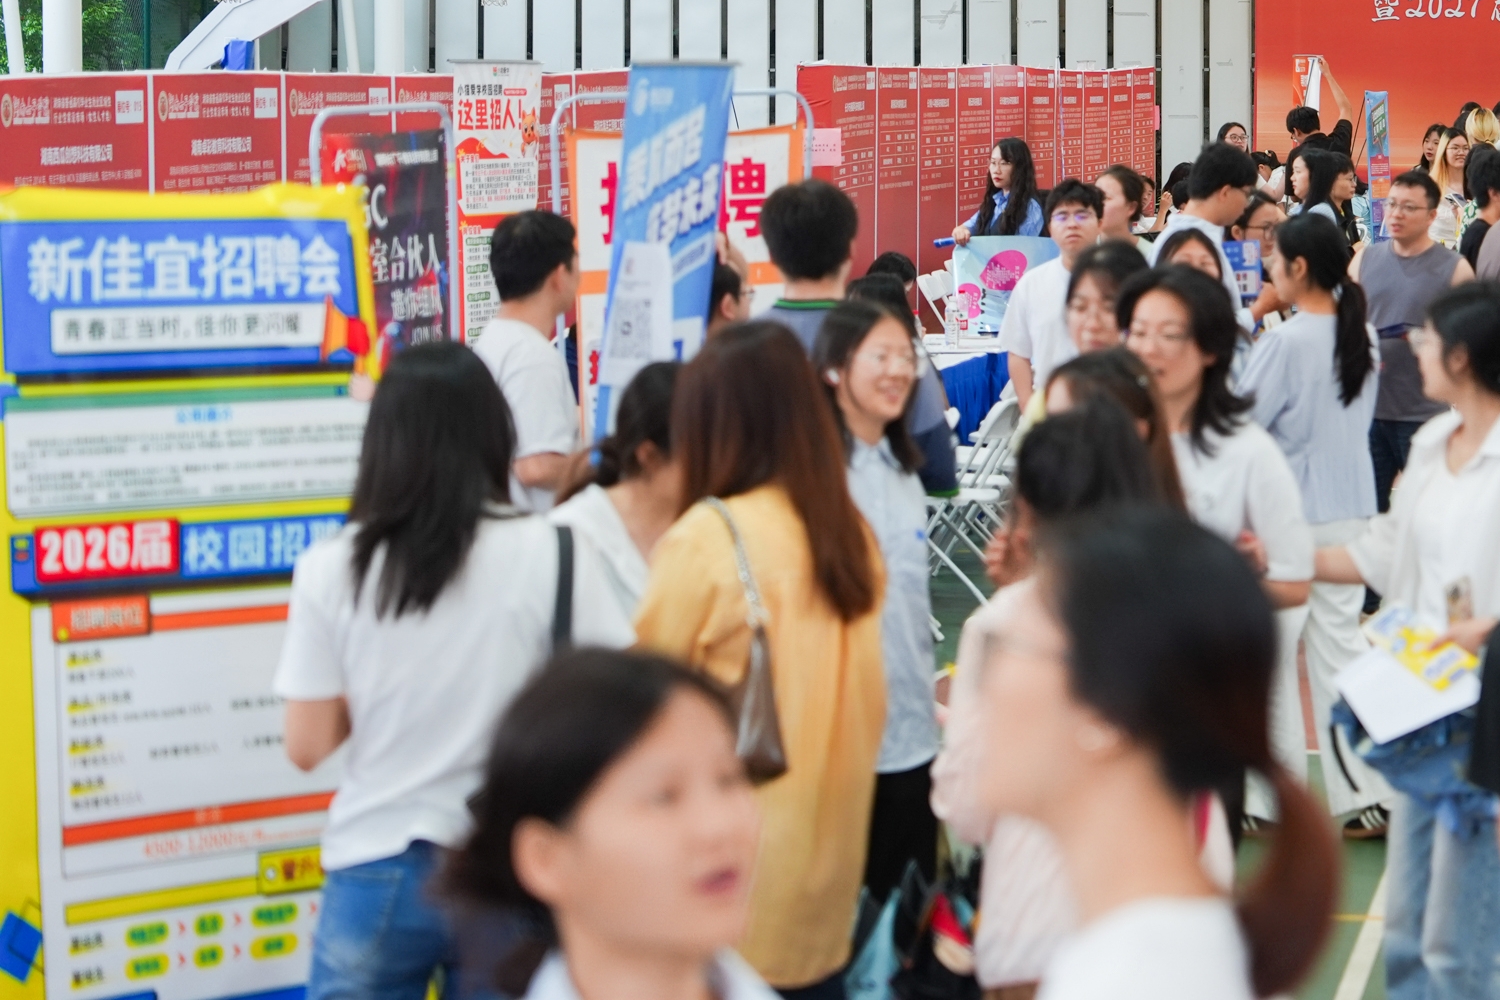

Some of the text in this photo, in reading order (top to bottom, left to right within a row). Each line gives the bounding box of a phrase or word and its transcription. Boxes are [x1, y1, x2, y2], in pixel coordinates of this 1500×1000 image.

[457, 99, 522, 131] 这里招人!
[28, 234, 341, 303] 新佳宜招聘会
[40, 519, 172, 575] 2026届
